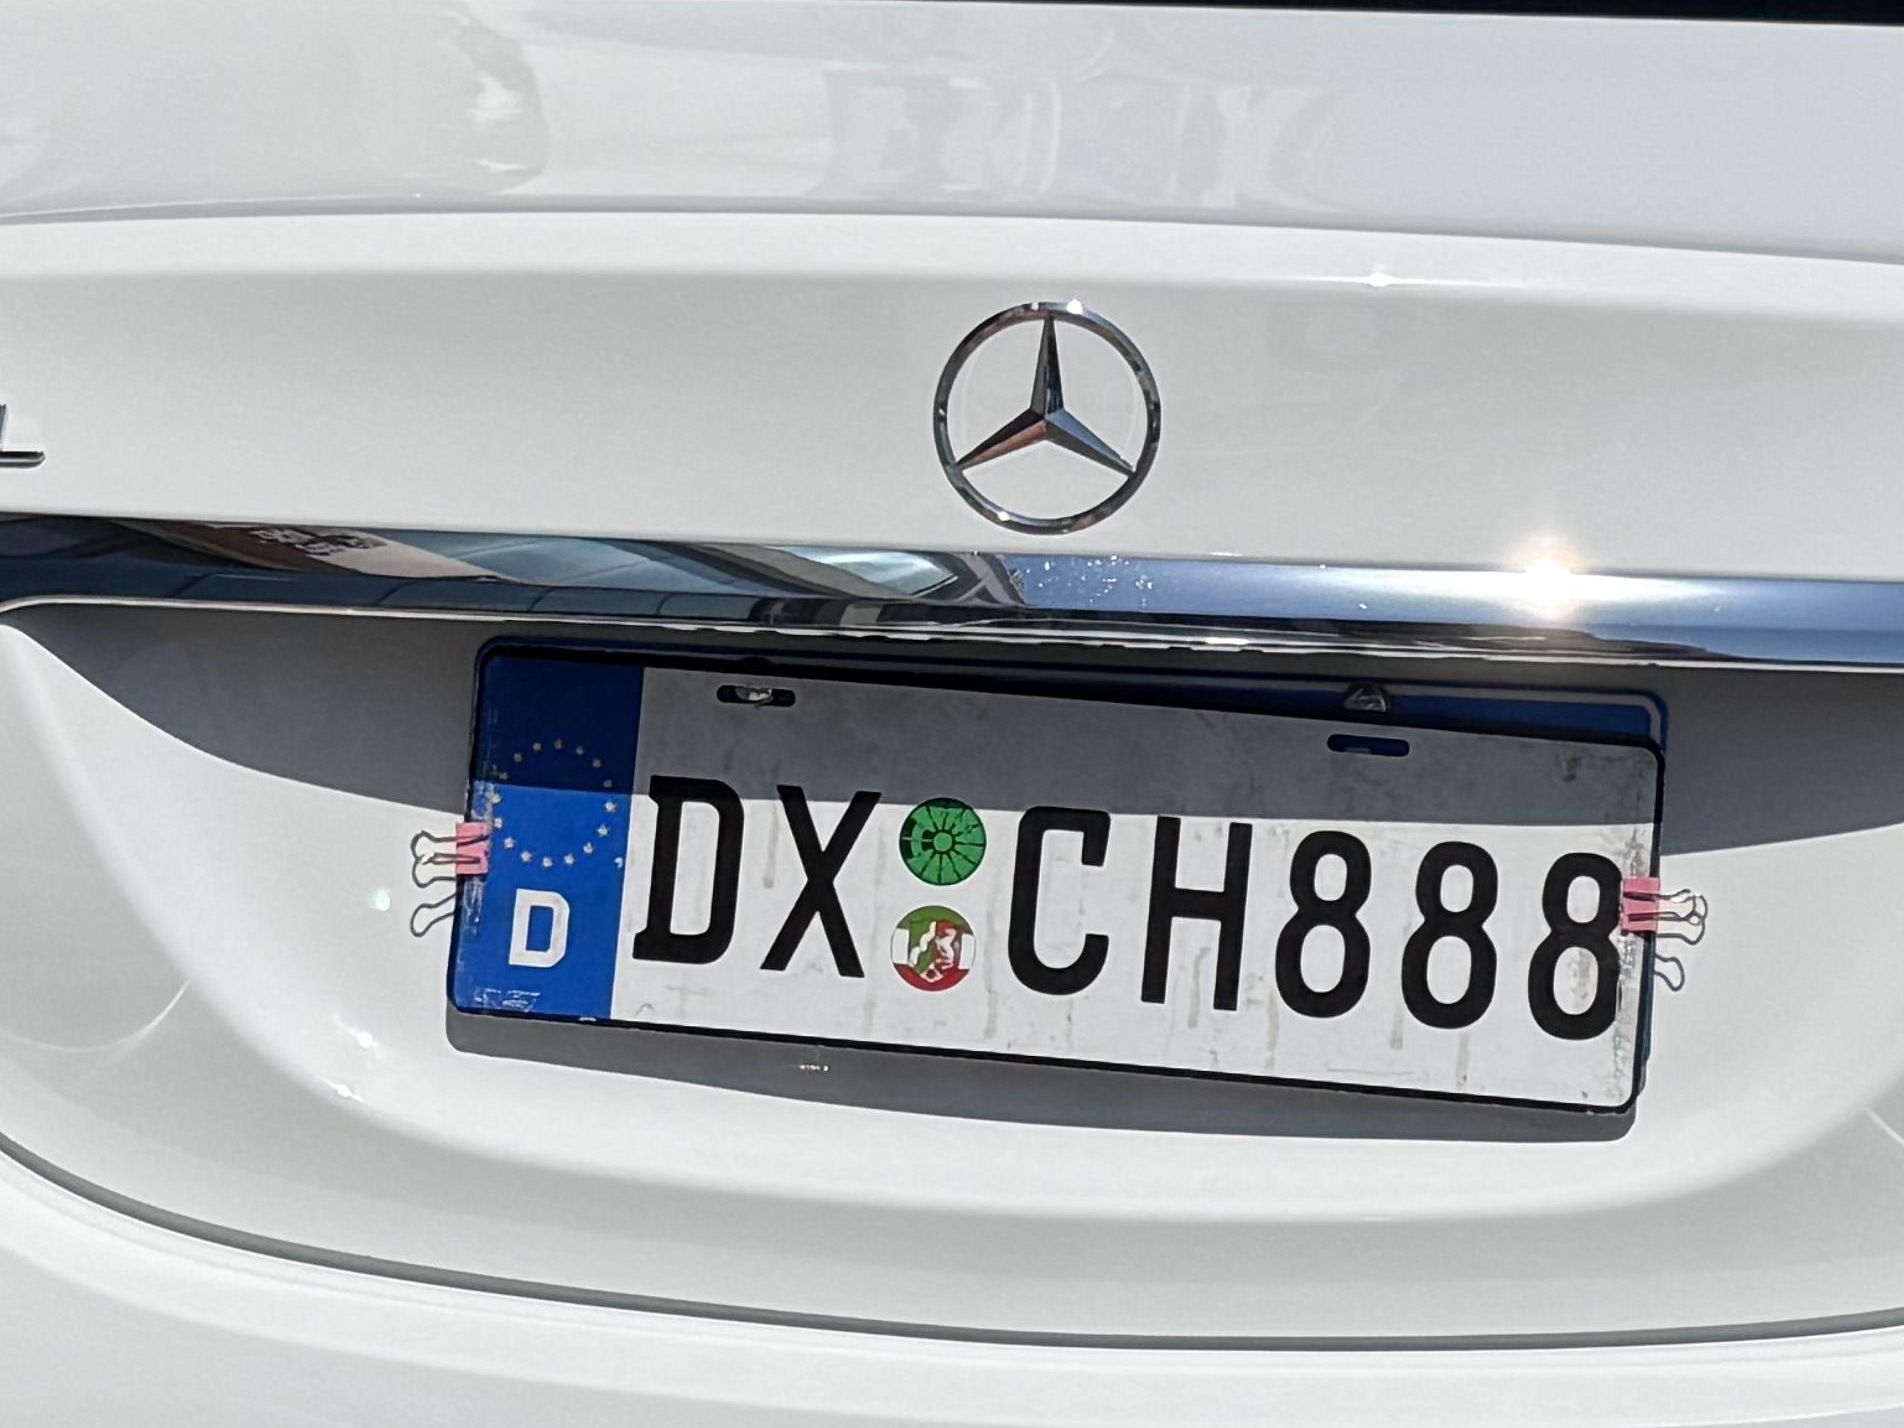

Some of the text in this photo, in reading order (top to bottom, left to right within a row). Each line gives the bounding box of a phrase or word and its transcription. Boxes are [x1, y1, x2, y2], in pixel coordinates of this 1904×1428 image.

[509, 888, 570, 968] D
[632, 775, 1624, 1041] DX CH888
